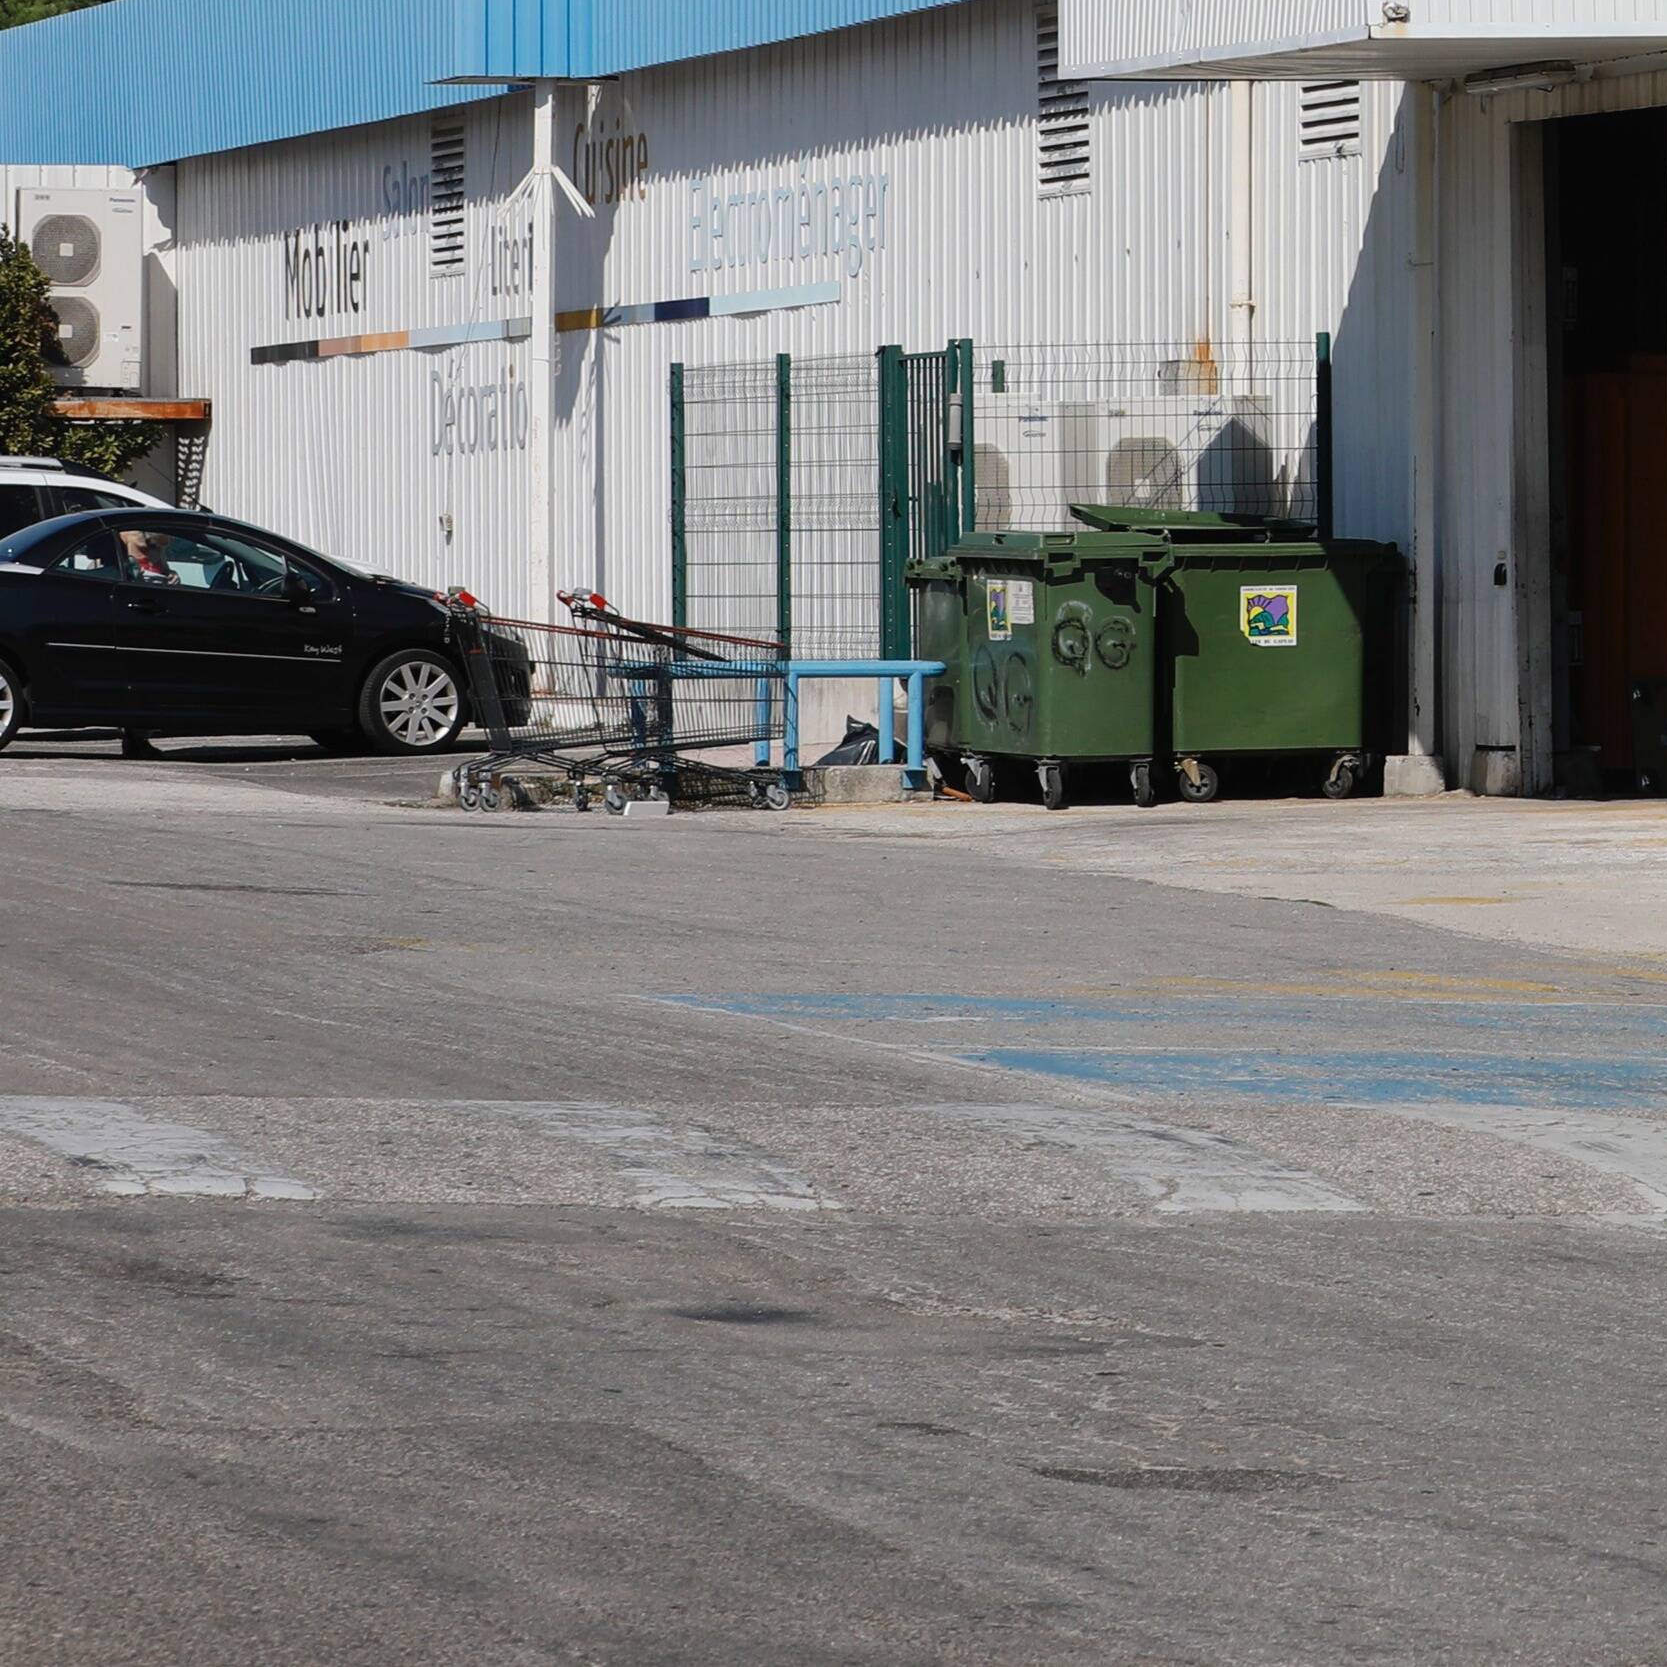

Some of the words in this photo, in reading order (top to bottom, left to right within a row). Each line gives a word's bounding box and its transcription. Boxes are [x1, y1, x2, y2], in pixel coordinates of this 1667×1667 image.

[382, 160, 430, 241] Salon
[573, 118, 649, 206] Cuisine
[284, 218, 371, 321] Mobilier
[491, 220, 534, 297] Literi
[430, 357, 529, 457] Décoratio
